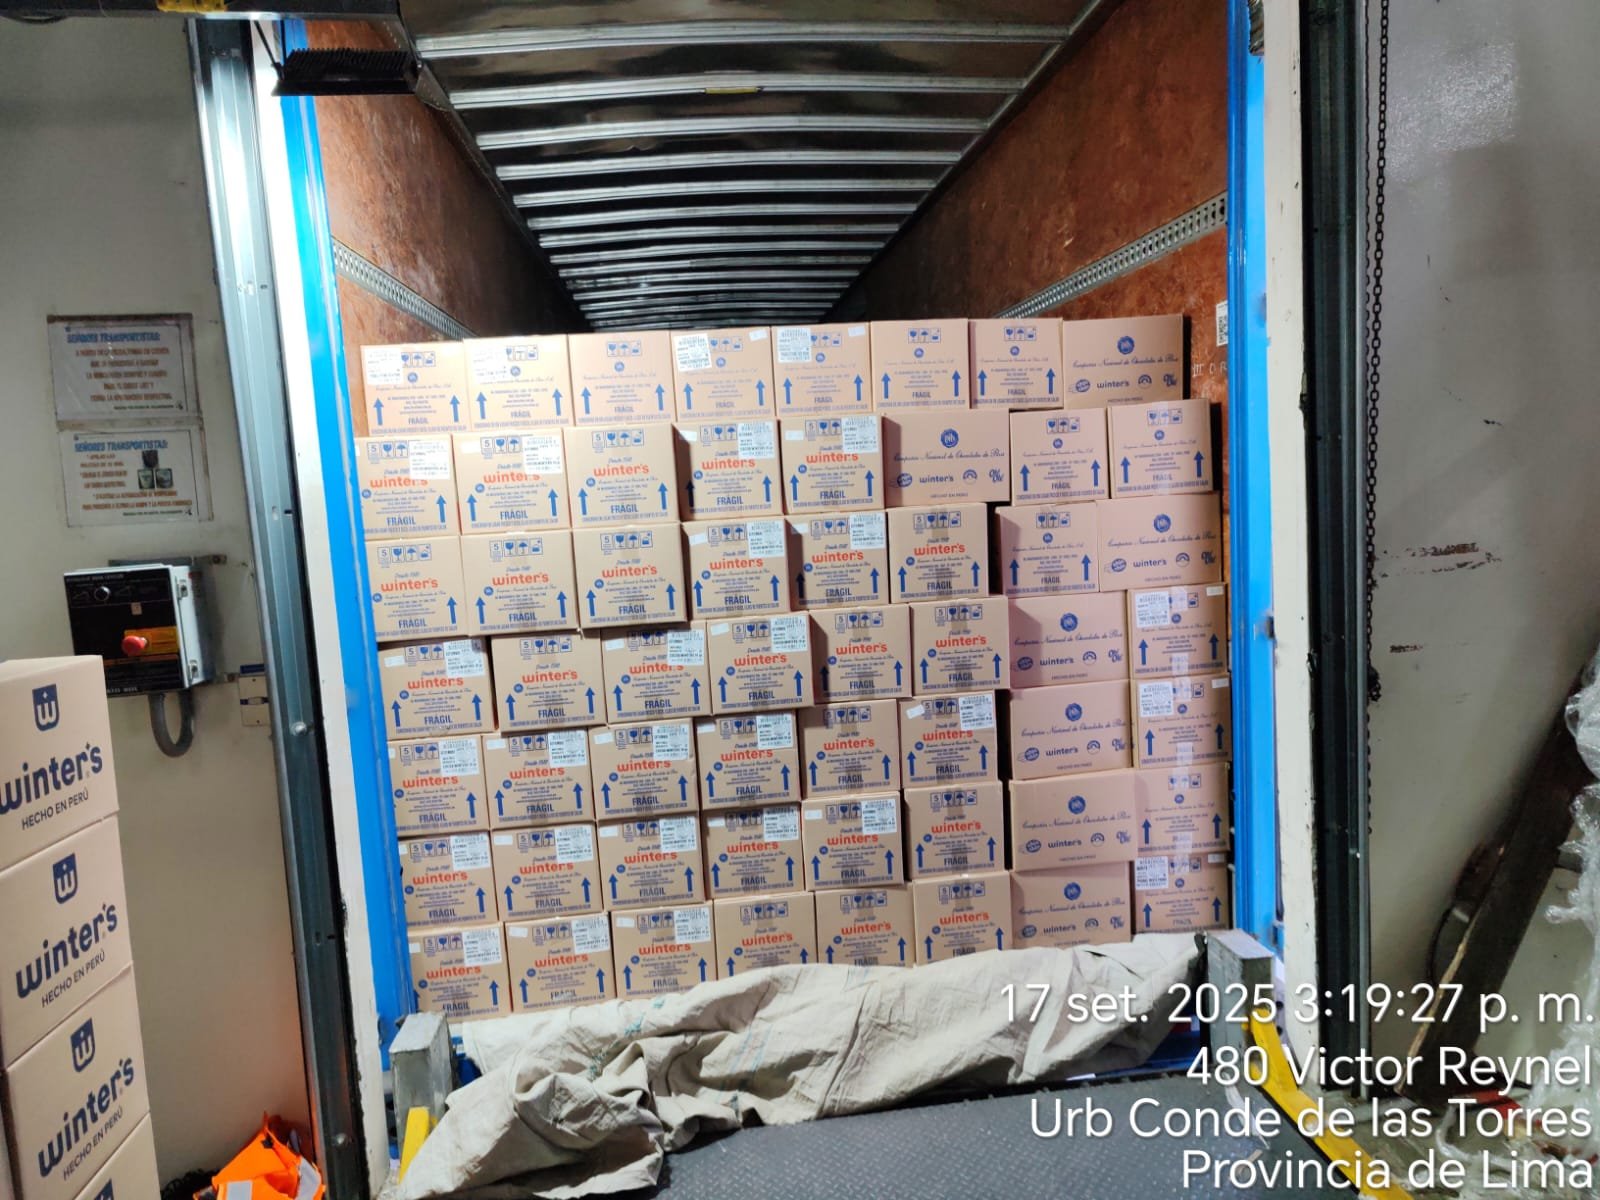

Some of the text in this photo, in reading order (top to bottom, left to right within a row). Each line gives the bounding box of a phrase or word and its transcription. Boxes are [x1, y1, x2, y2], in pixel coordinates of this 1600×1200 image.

[806, 452, 860, 464] winters
[594, 465, 648, 476] winter's
[370, 476, 426, 489] wintes
[484, 472, 538, 483] wintes
[913, 543, 966, 557] winter's
[812, 551, 863, 563] winter's
[602, 565, 656, 578] winter's
[382, 579, 438, 592] winter's
[492, 574, 548, 586] winter's
[935, 635, 987, 649] winter's
[836, 643, 887, 655] winter's
[735, 654, 787, 666] winter's
[629, 663, 683, 675] wintes
[407, 677, 464, 689] winters
[522, 671, 577, 684] winter's
[922, 729, 973, 742] winters
[823, 737, 874, 751] winter's
[720, 749, 773, 762] winters
[617, 759, 671, 772] winters
[0, 742, 102, 815] winter's
[509, 767, 564, 780] winters
[402, 776, 458, 789] winters
[22, 788, 89, 830] HECHO EN PERÚ
[931, 820, 982, 834] winter's
[827, 834, 879, 846] winters
[727, 842, 780, 853] winters
[624, 852, 677, 864] winters
[519, 862, 574, 875] winters
[939, 911, 990, 925] winter's
[841, 922, 891, 936] winter's
[742, 932, 793, 947] winter's
[16, 903, 117, 998] winter's
[639, 943, 691, 955] winters
[535, 954, 588, 968] winters
[42, 949, 105, 1008] HECHO EN PERÚ
[426, 966, 480, 979] winters
[38, 1057, 134, 1178] winter's
[63, 1106, 123, 1181] HECHO EN PERÚ
